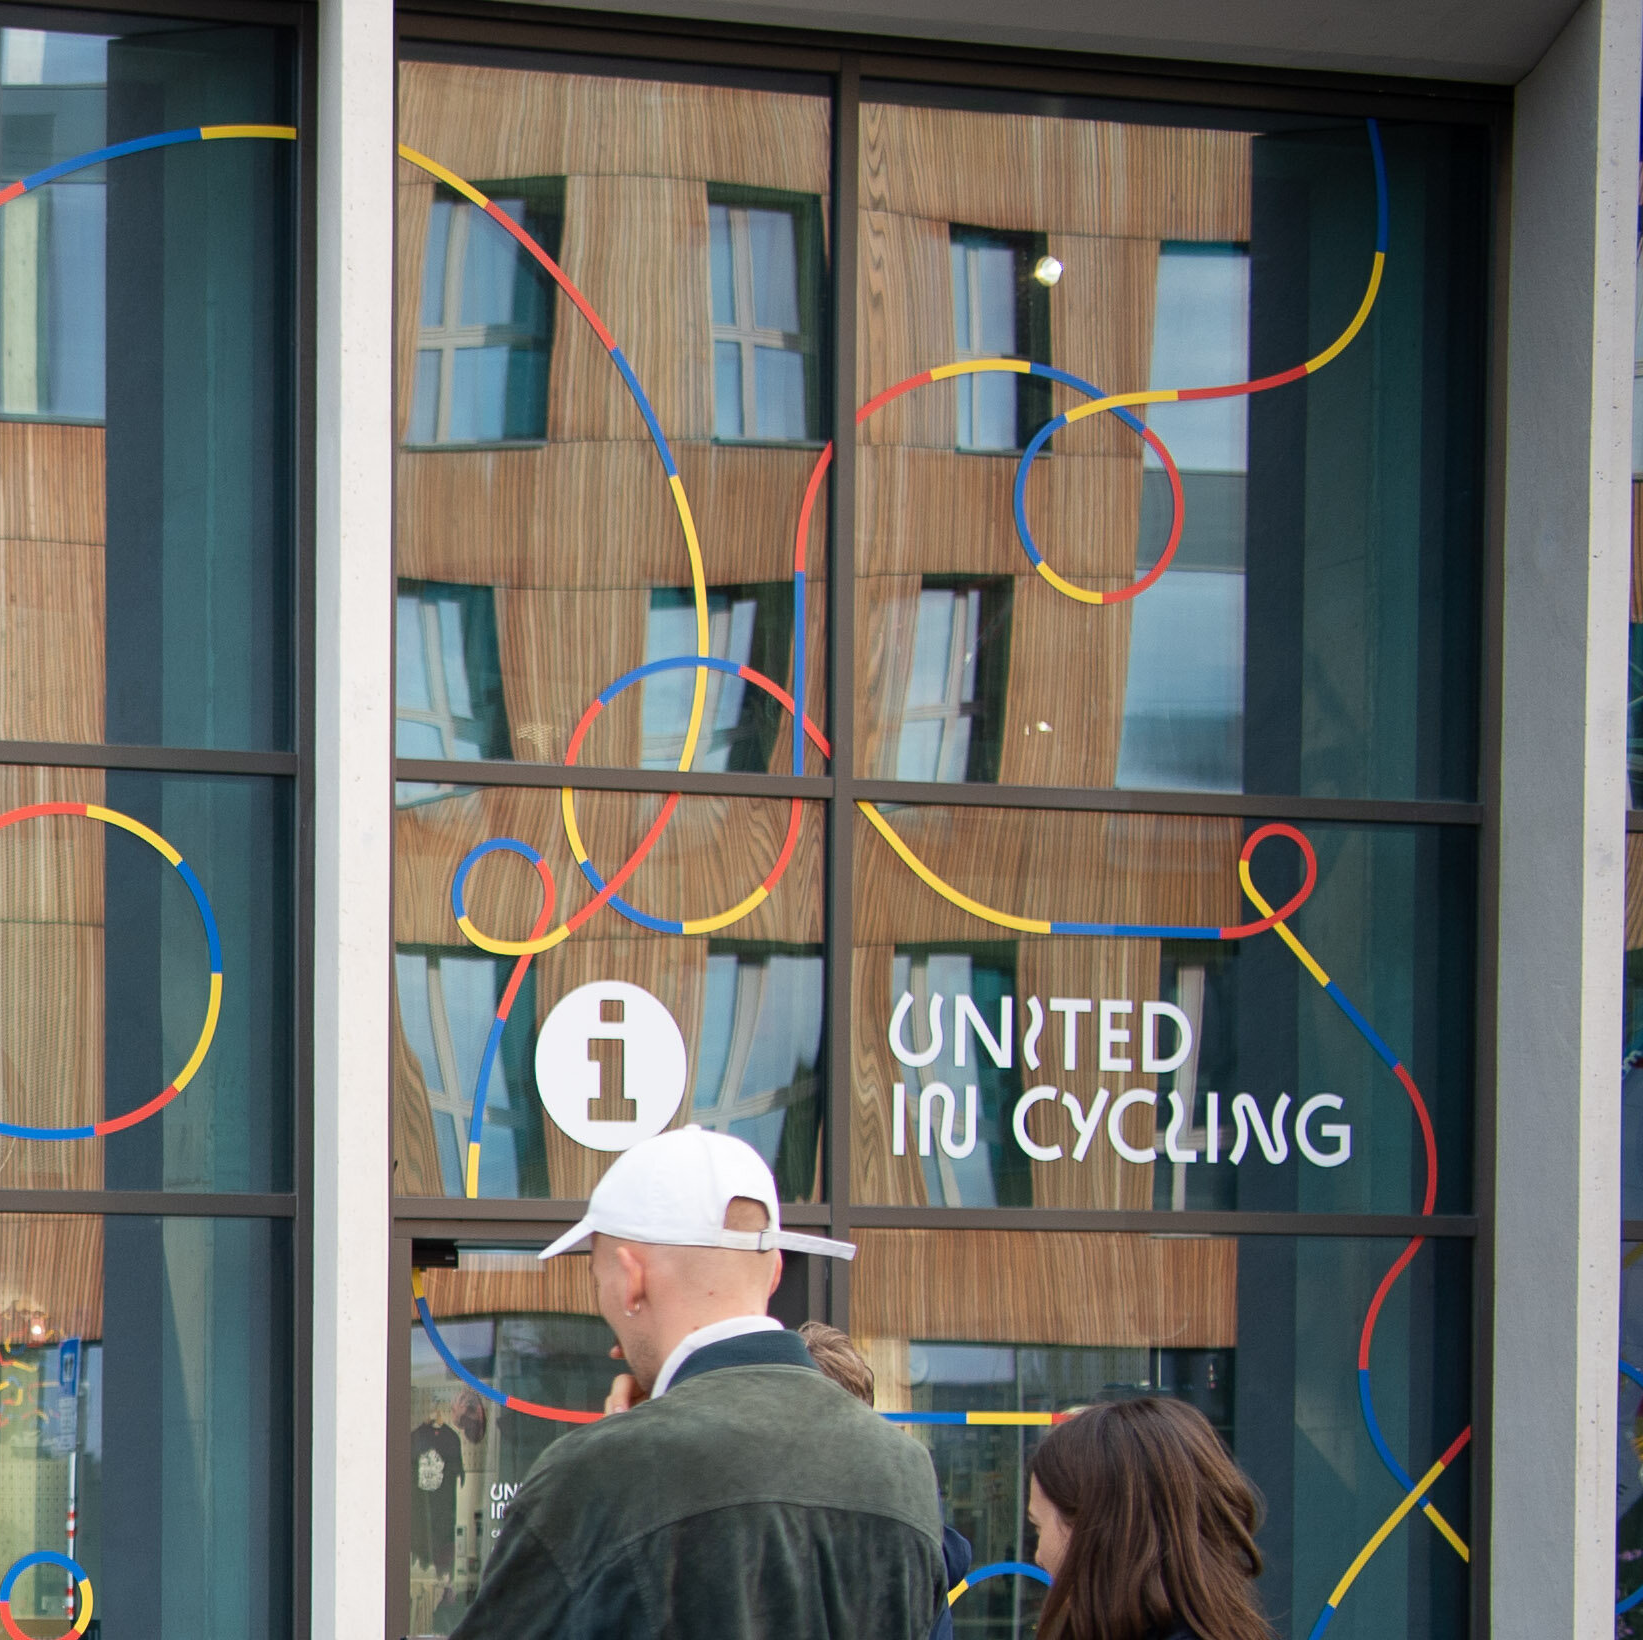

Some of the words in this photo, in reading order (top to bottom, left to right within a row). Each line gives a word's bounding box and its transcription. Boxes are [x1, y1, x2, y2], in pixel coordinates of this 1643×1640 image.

[888, 990, 1194, 1074] UNITED
[892, 1082, 978, 1159] IN
[1012, 1086, 1353, 1168] CYCLING
